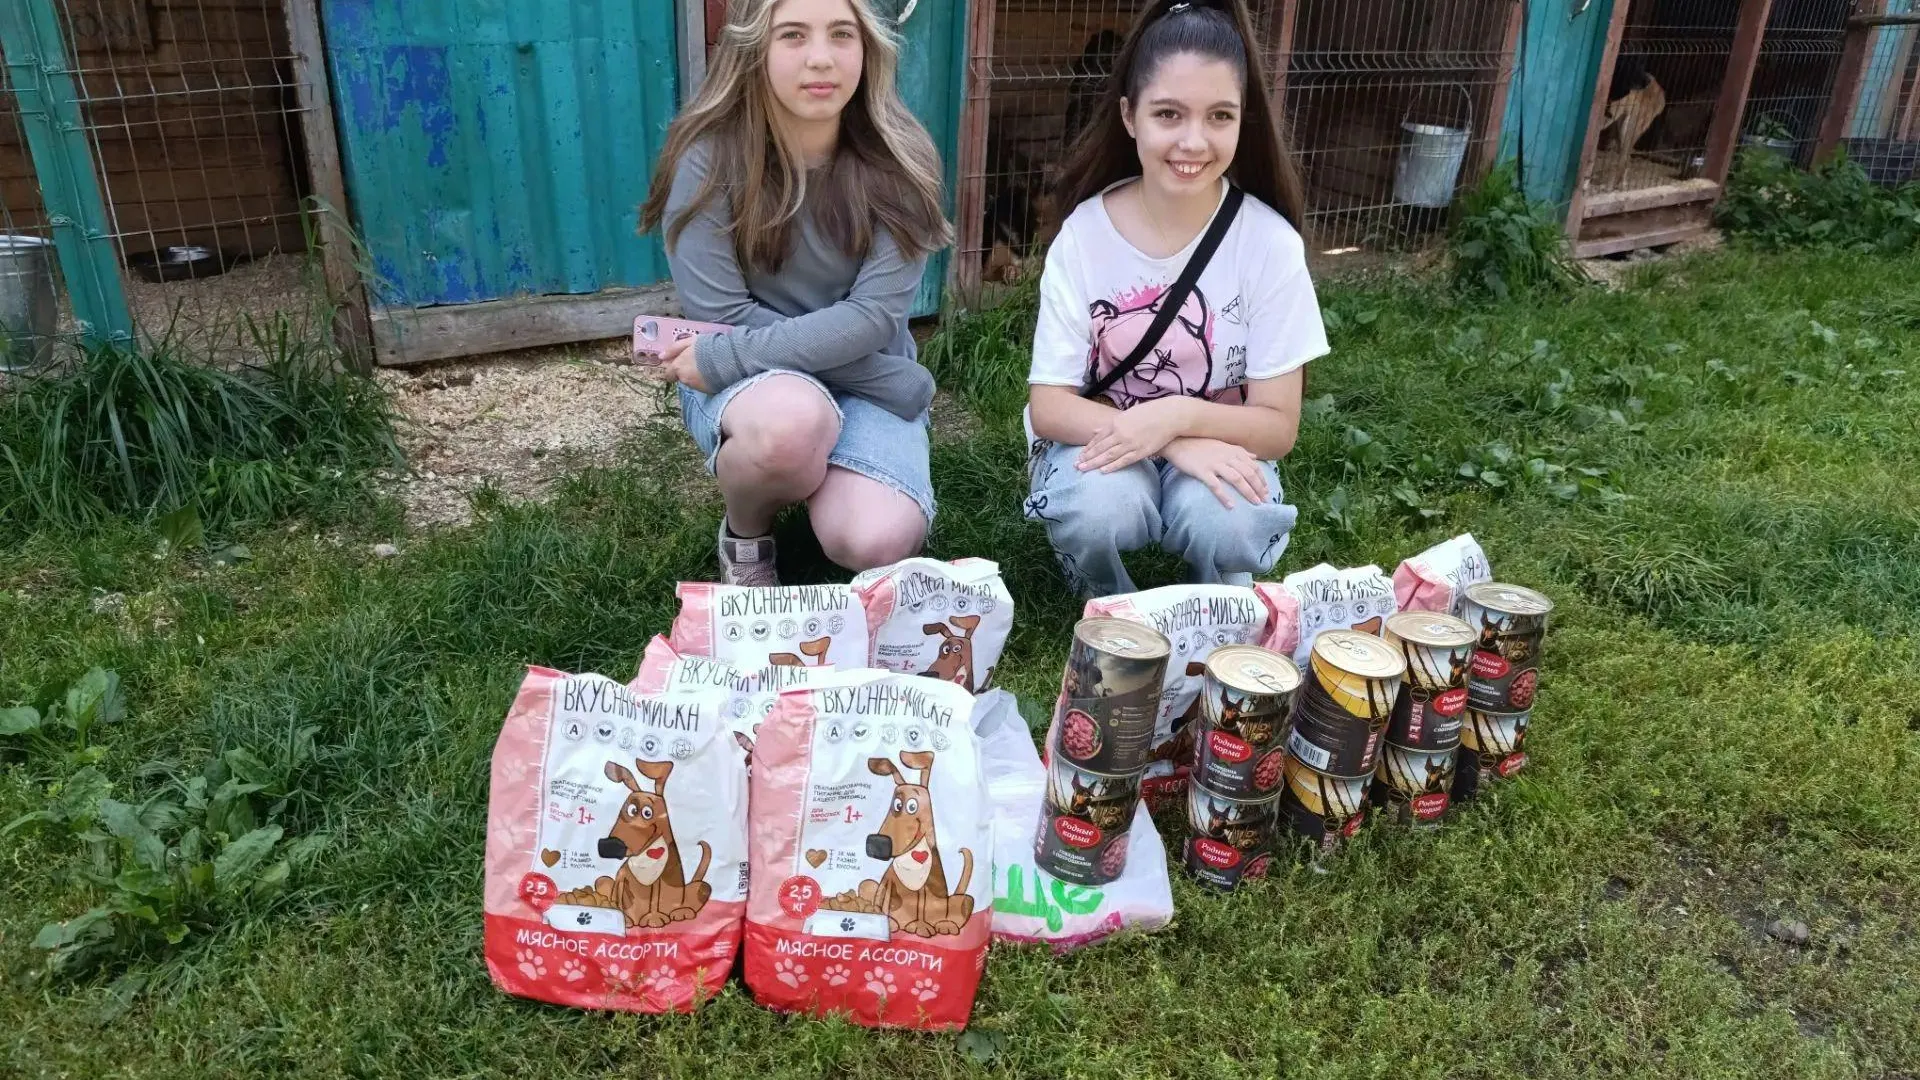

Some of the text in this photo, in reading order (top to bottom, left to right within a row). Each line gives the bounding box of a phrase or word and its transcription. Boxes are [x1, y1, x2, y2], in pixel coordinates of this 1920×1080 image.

[721, 585, 848, 616] ВКУСНАЯ МИСКА
[1150, 597, 1256, 634] ВКУСНАЯ МИСКА
[564, 679, 700, 732] ВКУСНАЯ МИСКА
[823, 684, 899, 716] ВКУСНАЯ
[1213, 734, 1245, 751] Родные
[1213, 743, 1241, 758] корма
[578, 806, 595, 824] 1+
[844, 805, 863, 823] 1+
[1062, 820, 1094, 836] Родные
[1062, 830, 1090, 843] корма
[1201, 842, 1232, 857] Родные
[1202, 852, 1229, 864] корма
[789, 885, 812, 901] 2,5
[516, 928, 678, 961] МЯСНОЕ АССОРТИ
[775, 938, 943, 973] МЯСНОЕ АССОРТИ
